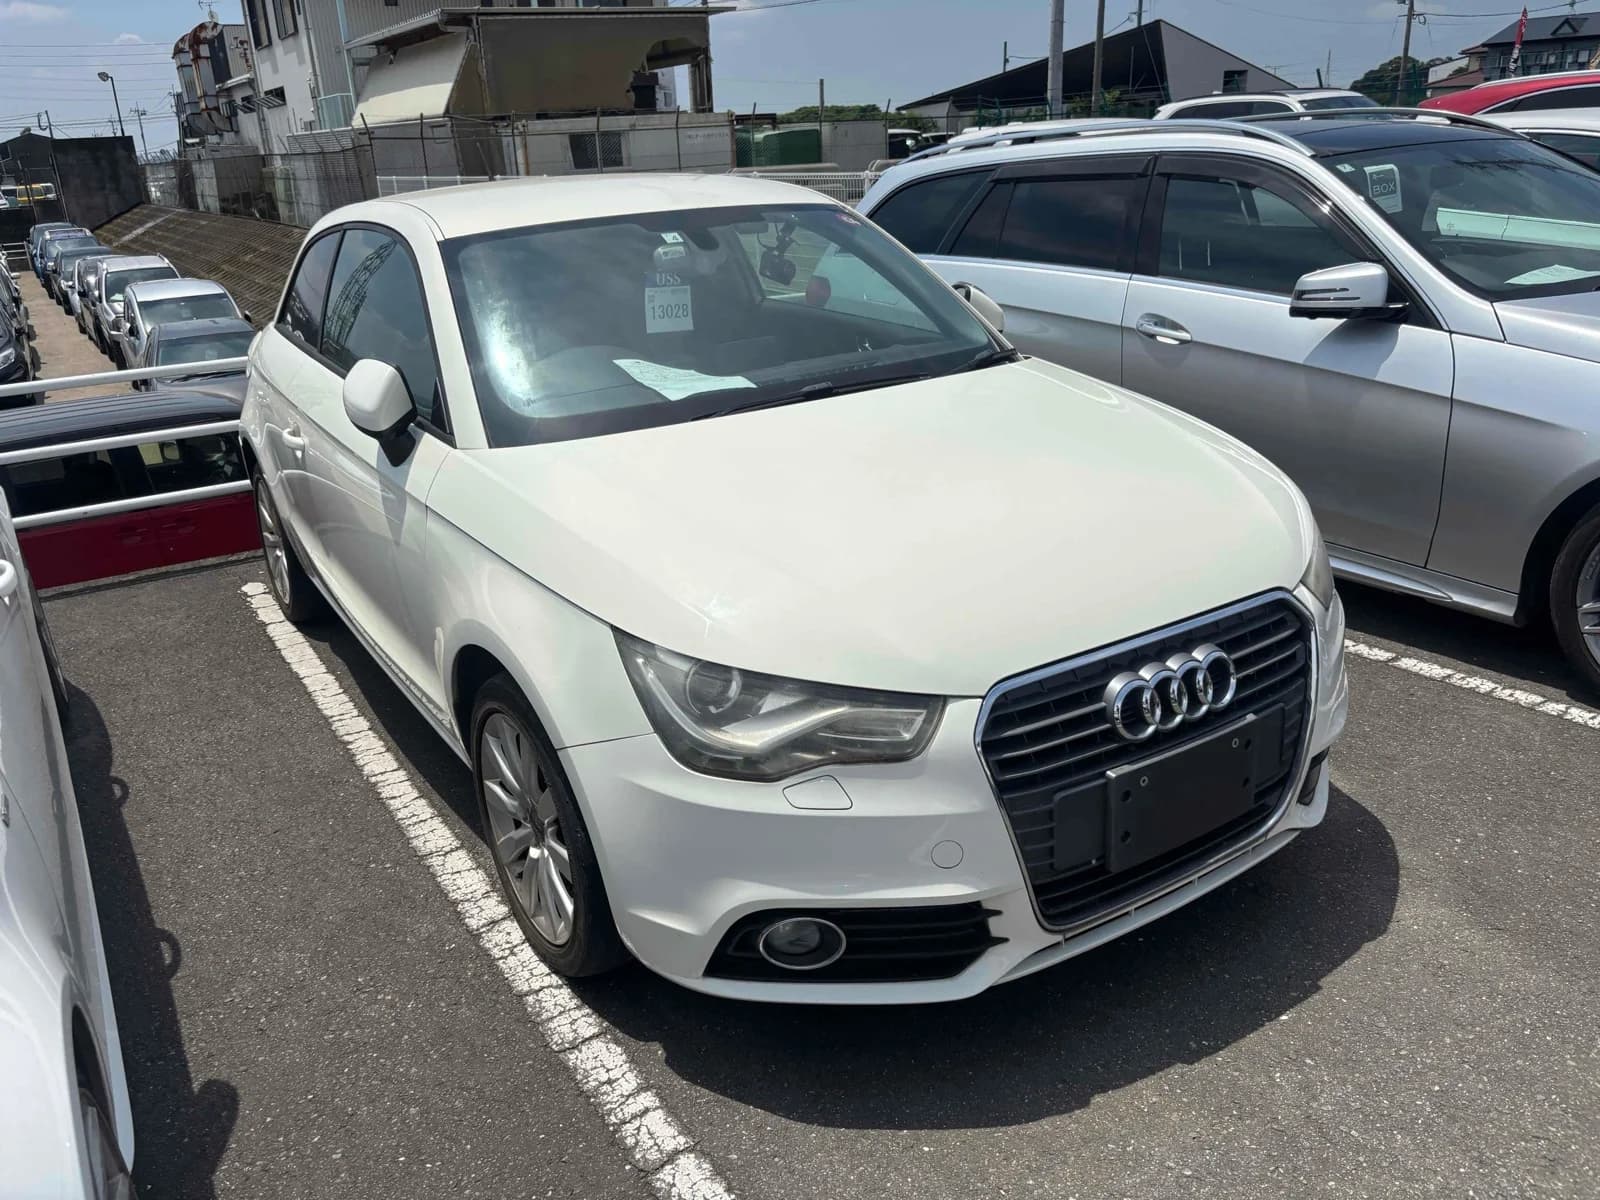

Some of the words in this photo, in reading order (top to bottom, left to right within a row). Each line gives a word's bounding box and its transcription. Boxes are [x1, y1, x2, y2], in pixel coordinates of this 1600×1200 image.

[1373, 181, 1395, 194] BOX
[656, 272, 681, 285] USS
[650, 303, 689, 320] 13028
